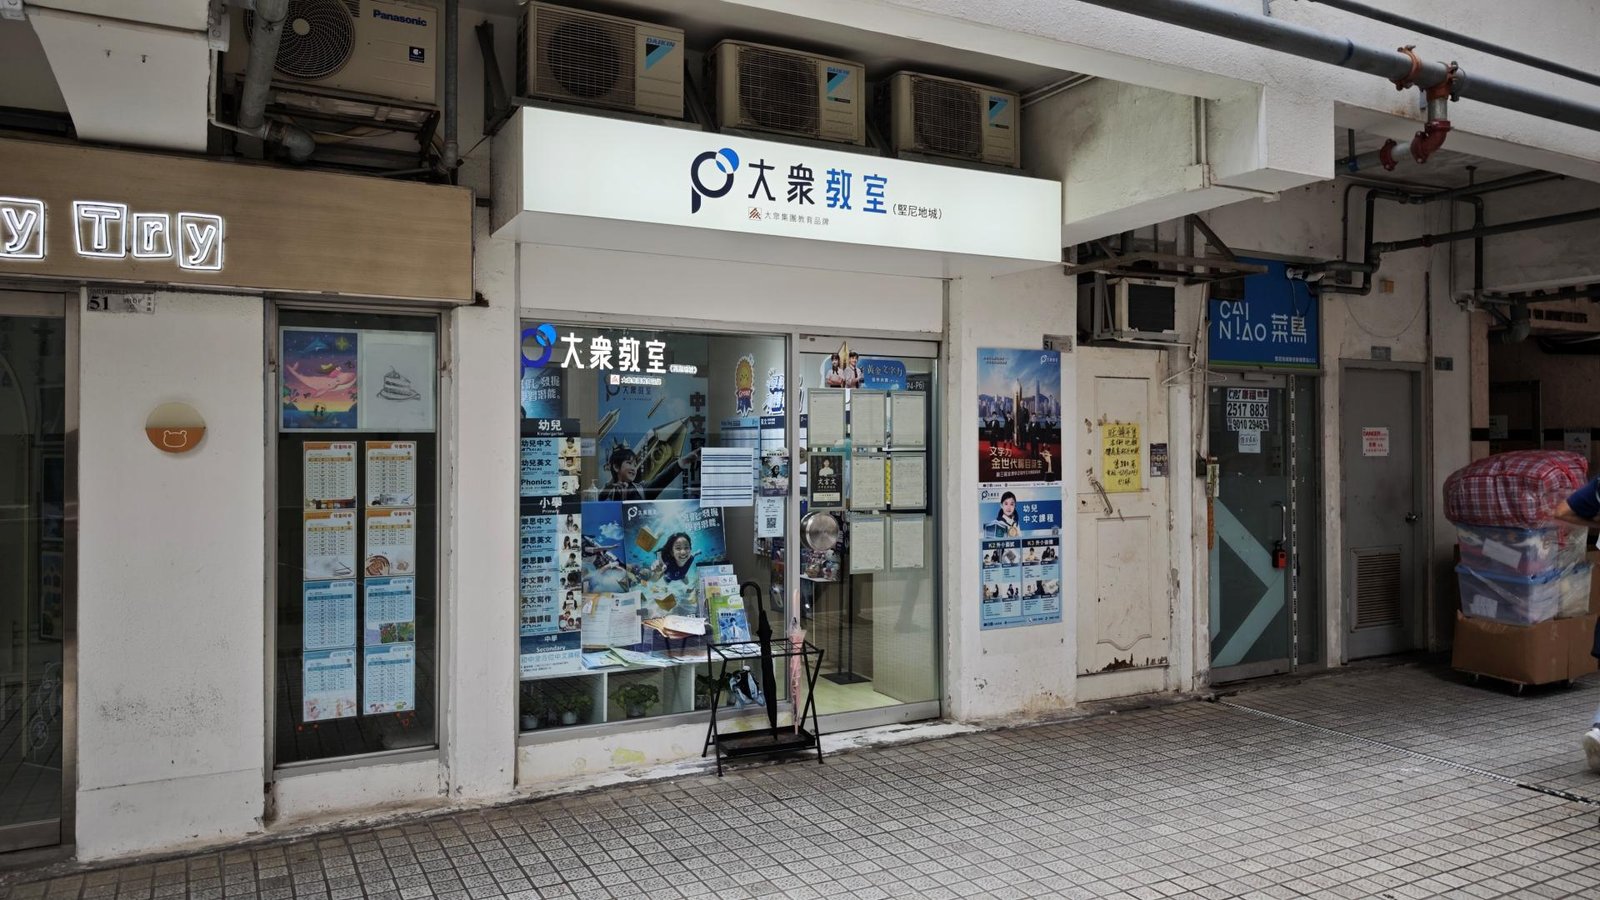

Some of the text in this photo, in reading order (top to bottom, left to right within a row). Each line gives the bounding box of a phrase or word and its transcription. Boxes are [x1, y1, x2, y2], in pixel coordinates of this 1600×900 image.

[373, 9, 427, 27] Panasonic
[646, 37, 675, 48] DAIKIN
[81, 208, 216, 264] Try
[89, 295, 108, 310] 51
[1220, 301, 1249, 320] CAI
[1043, 340, 1053, 351] 51
[1227, 403, 1269, 417] 2517 8831
[538, 419, 562, 431] 幼兒
[1233, 419, 1247, 430] 9010
[1023, 504, 1038, 512] 幼兒
